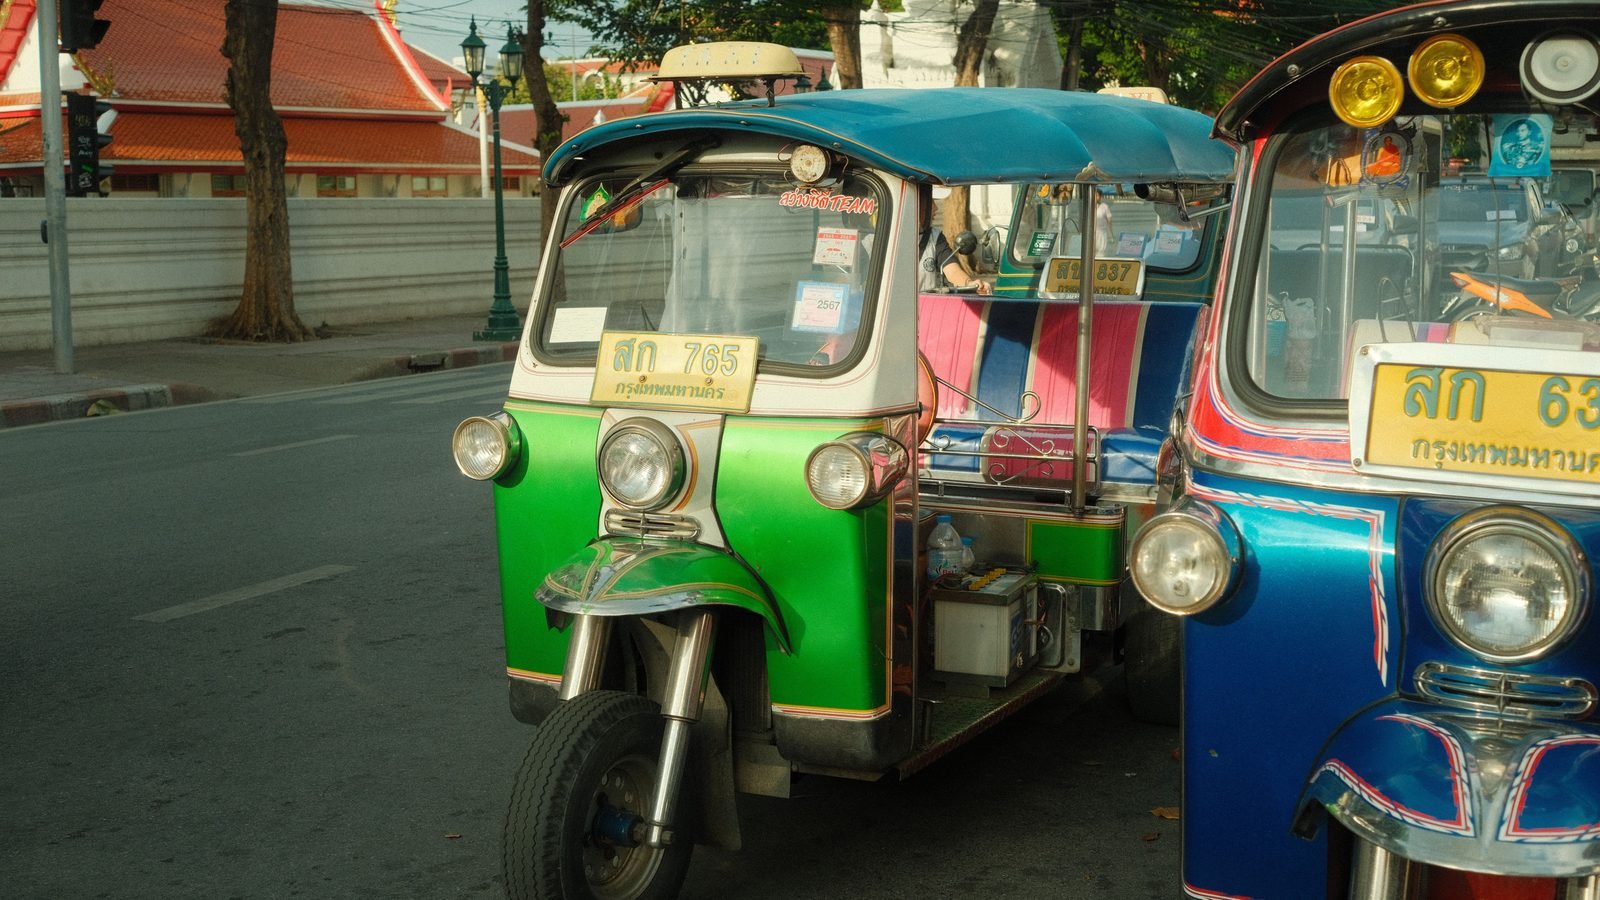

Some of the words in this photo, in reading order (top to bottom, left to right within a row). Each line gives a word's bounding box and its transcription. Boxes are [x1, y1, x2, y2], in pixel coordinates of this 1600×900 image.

[830, 194, 875, 215] TEAM
[1097, 263, 1131, 281] 837
[817, 300, 840, 311] 2567
[613, 338, 658, 372] สก
[684, 342, 740, 376] 765
[615, 381, 726, 400] กรุงเทพมหานคร
[1404, 367, 1486, 422] สก
